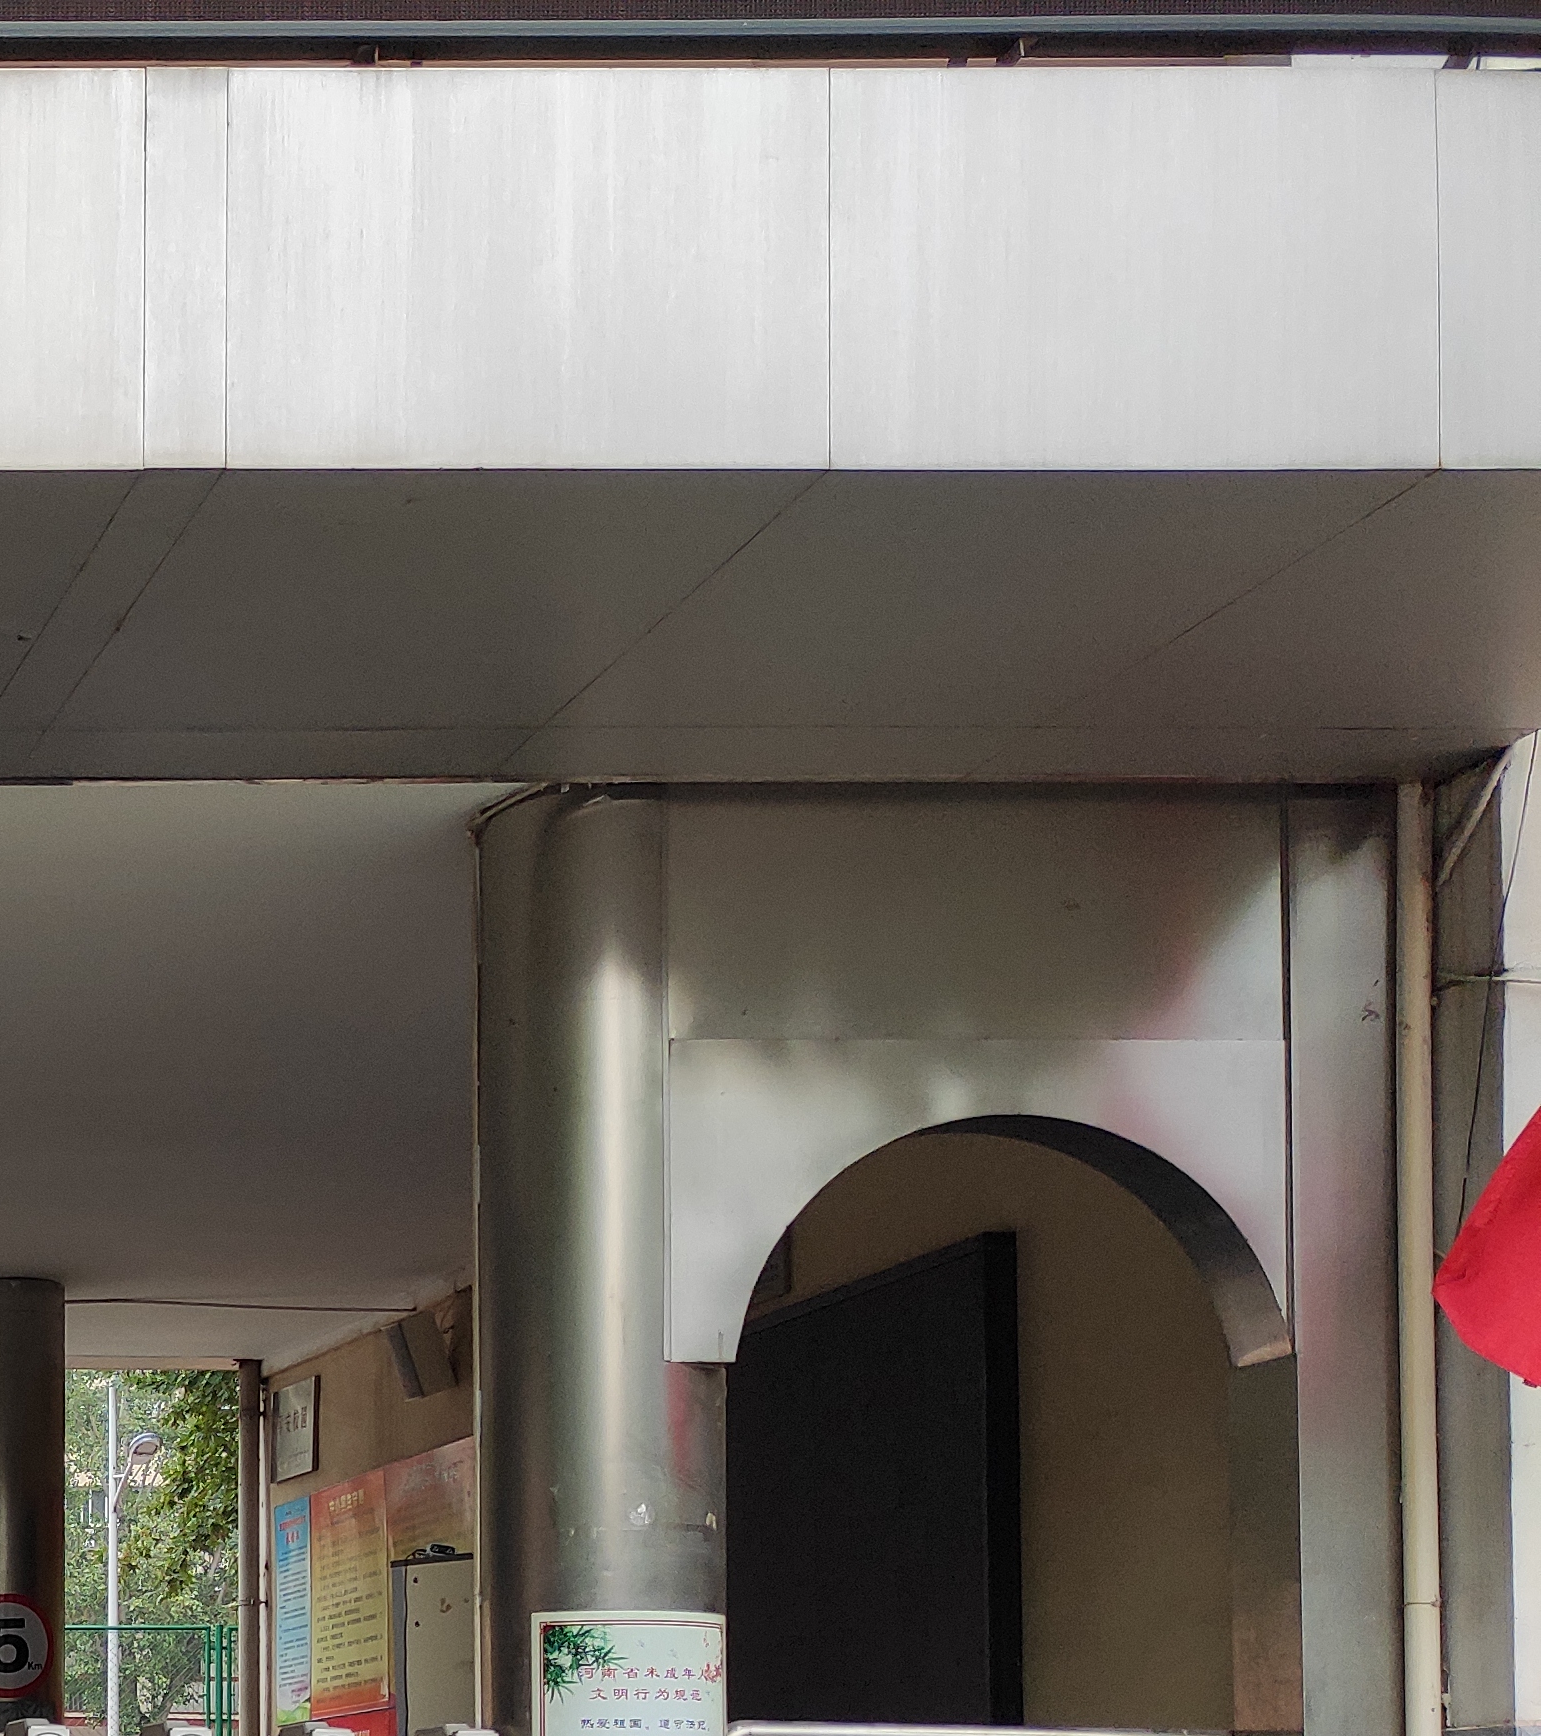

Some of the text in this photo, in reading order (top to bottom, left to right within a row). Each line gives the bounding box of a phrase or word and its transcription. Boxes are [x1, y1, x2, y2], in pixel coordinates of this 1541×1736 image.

[28, 1661, 43, 1671] Km
[589, 1688, 702, 1701] 文明行为规范
